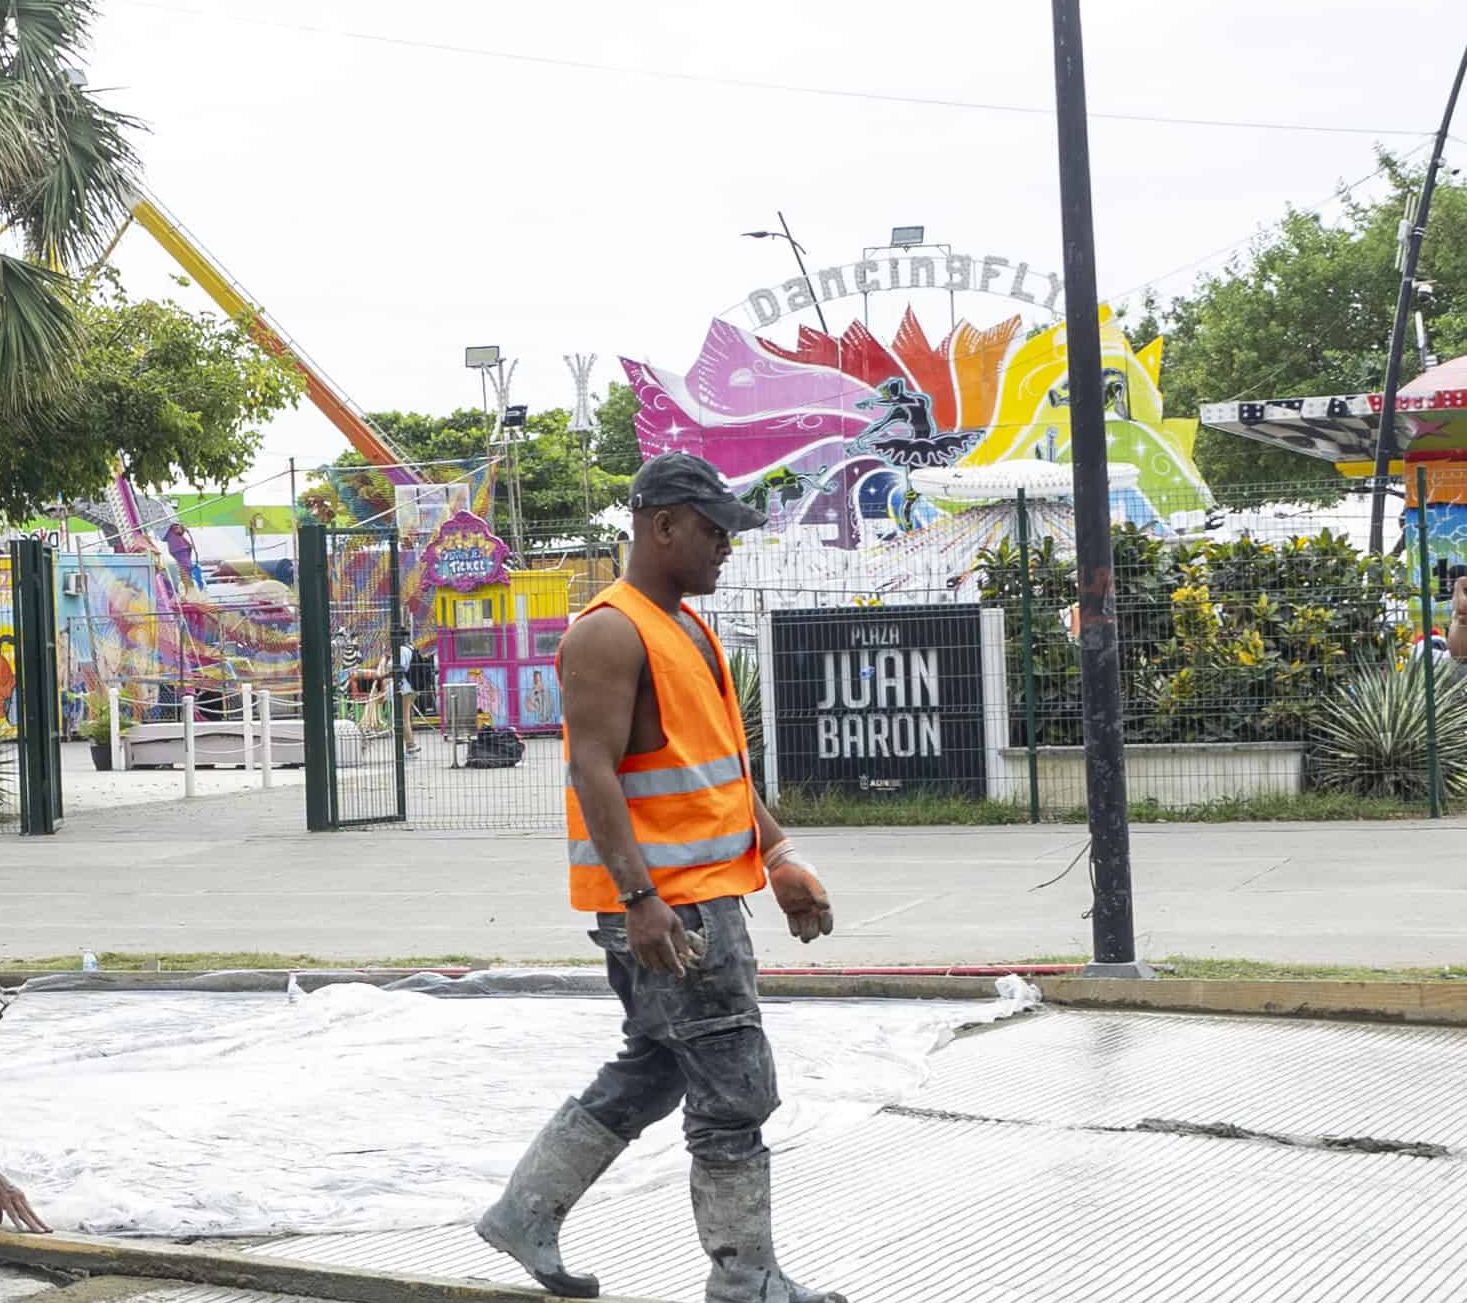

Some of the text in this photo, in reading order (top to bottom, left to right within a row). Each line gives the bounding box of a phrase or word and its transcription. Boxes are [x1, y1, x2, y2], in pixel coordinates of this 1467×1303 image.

[850, 623, 900, 646] PLAZA
[817, 648, 940, 710] JUAN
[817, 711, 942, 759] BARON
